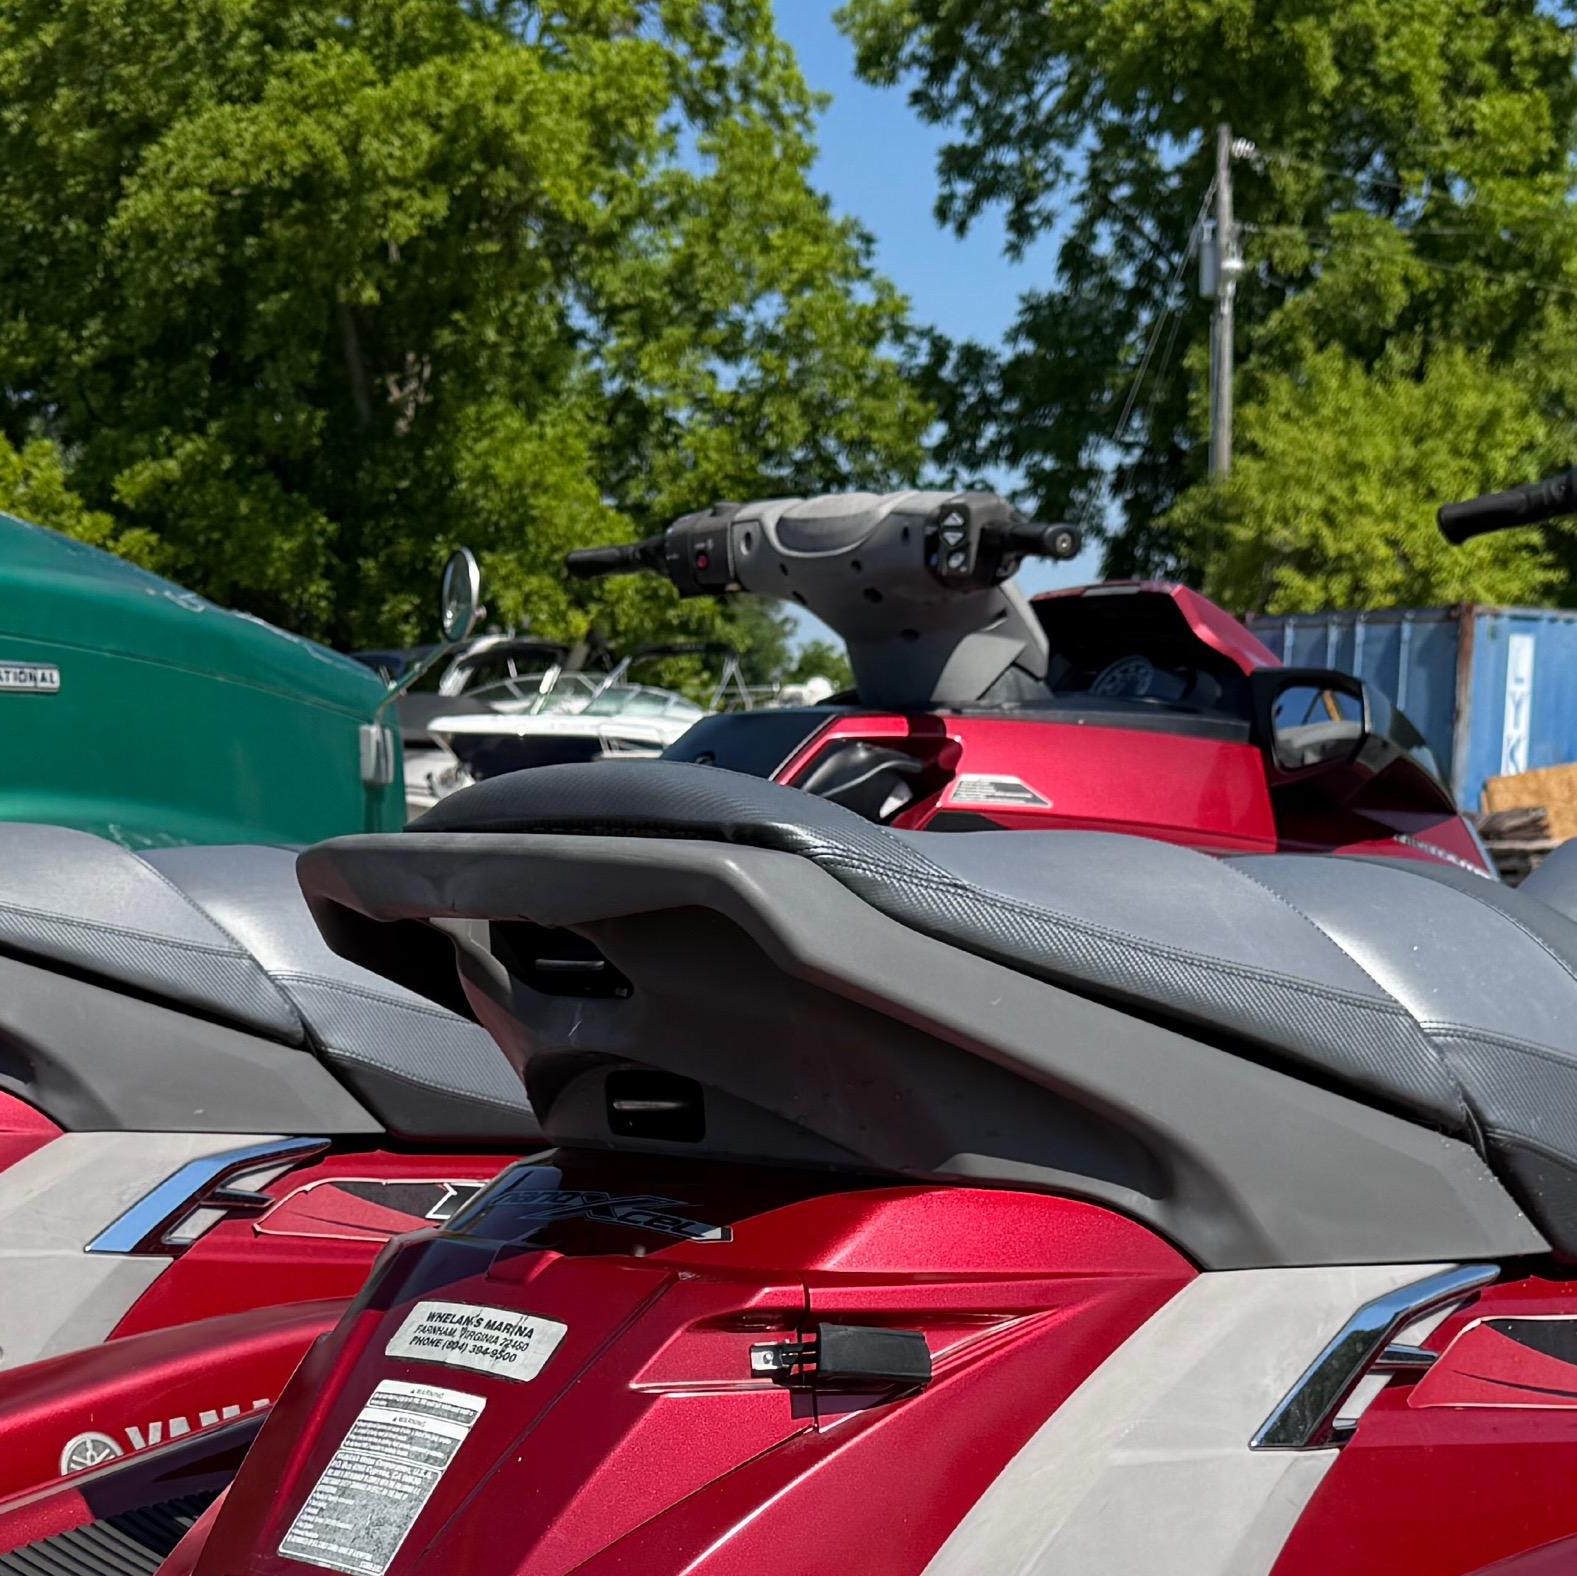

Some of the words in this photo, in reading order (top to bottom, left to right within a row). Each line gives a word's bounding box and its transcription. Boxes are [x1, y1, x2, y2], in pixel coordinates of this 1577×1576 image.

[426, 1311, 484, 1328] WHELAN'S
[483, 1318, 535, 1339] MARINA
[409, 1336, 440, 1348] PHONE
[442, 1340, 469, 1353] (804)
[459, 1327, 499, 1345] VIRGINIA
